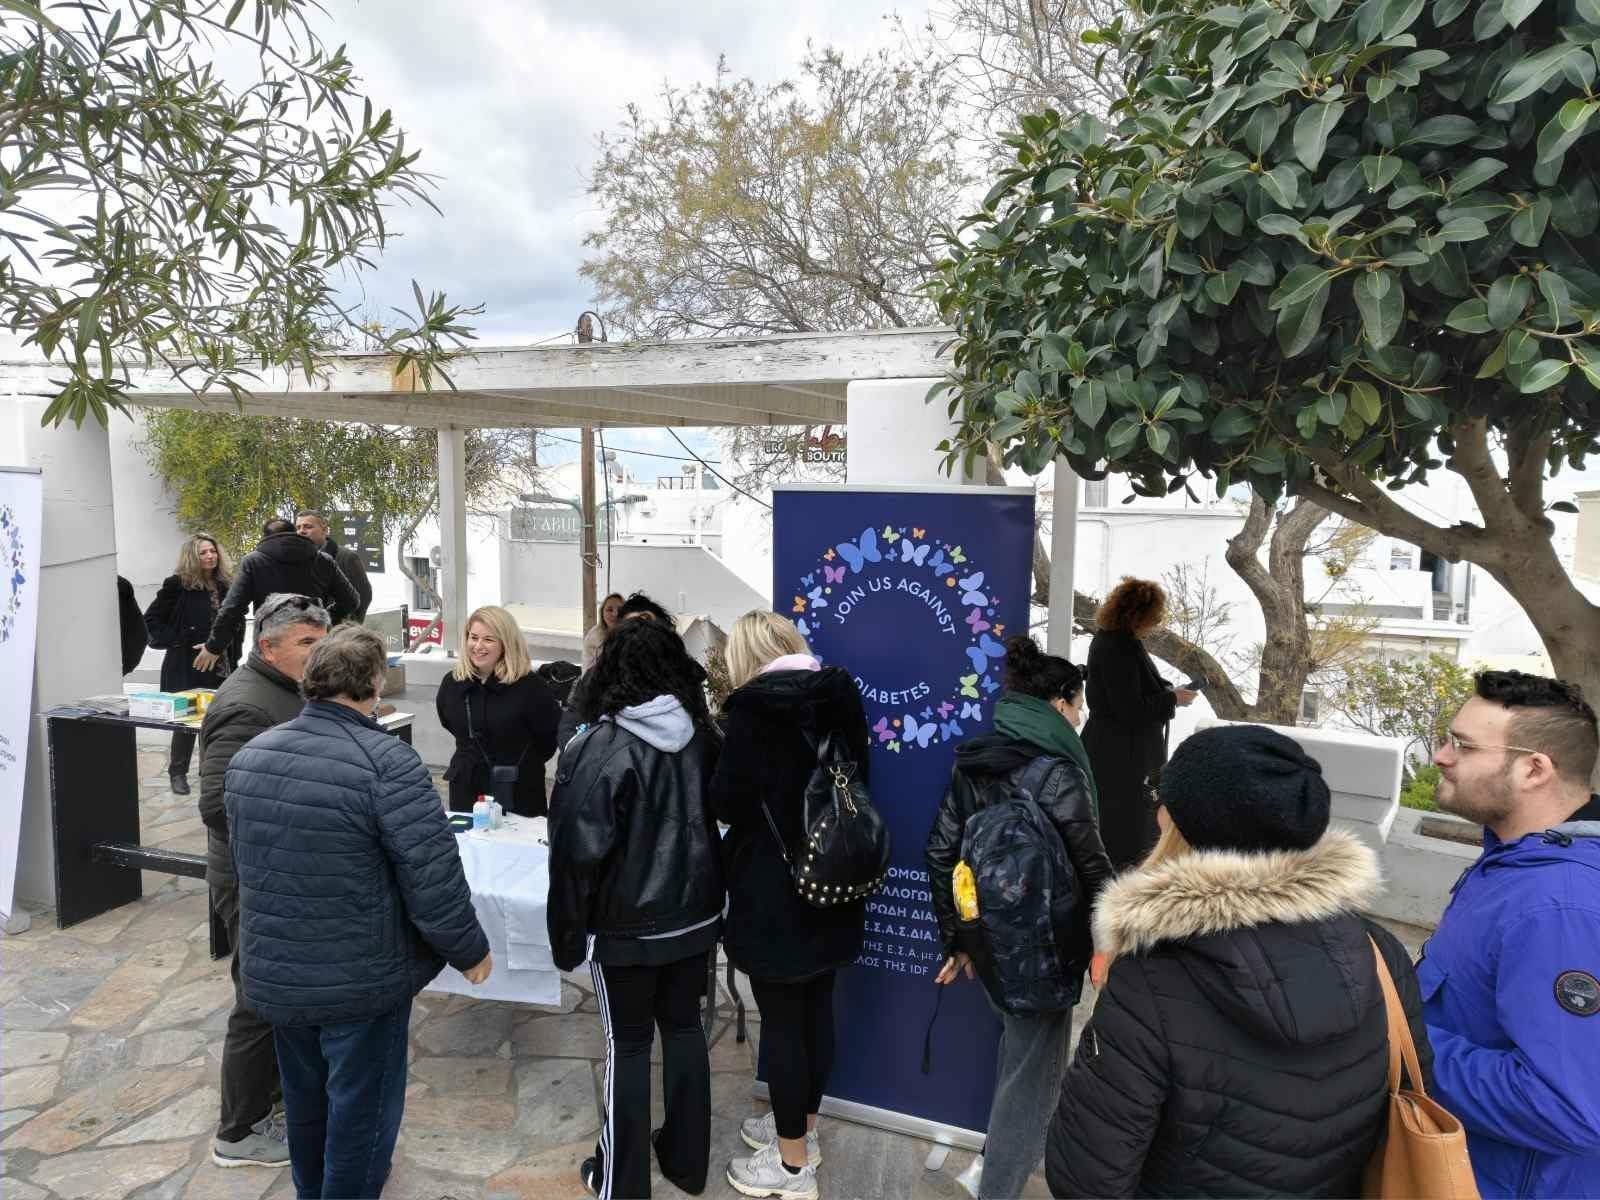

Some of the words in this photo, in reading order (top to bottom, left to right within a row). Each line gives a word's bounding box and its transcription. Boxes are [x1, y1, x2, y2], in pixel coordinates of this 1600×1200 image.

[834, 585, 866, 624] JOIN
[868, 576, 892, 593] US
[897, 578, 956, 635] AGAINST
[887, 866, 930, 883] ΟΜΟΣ
[854, 955, 880, 968] ΛΟΣ
[883, 959, 907, 973] ΤΗΣ
[910, 965, 929, 976] IDF
